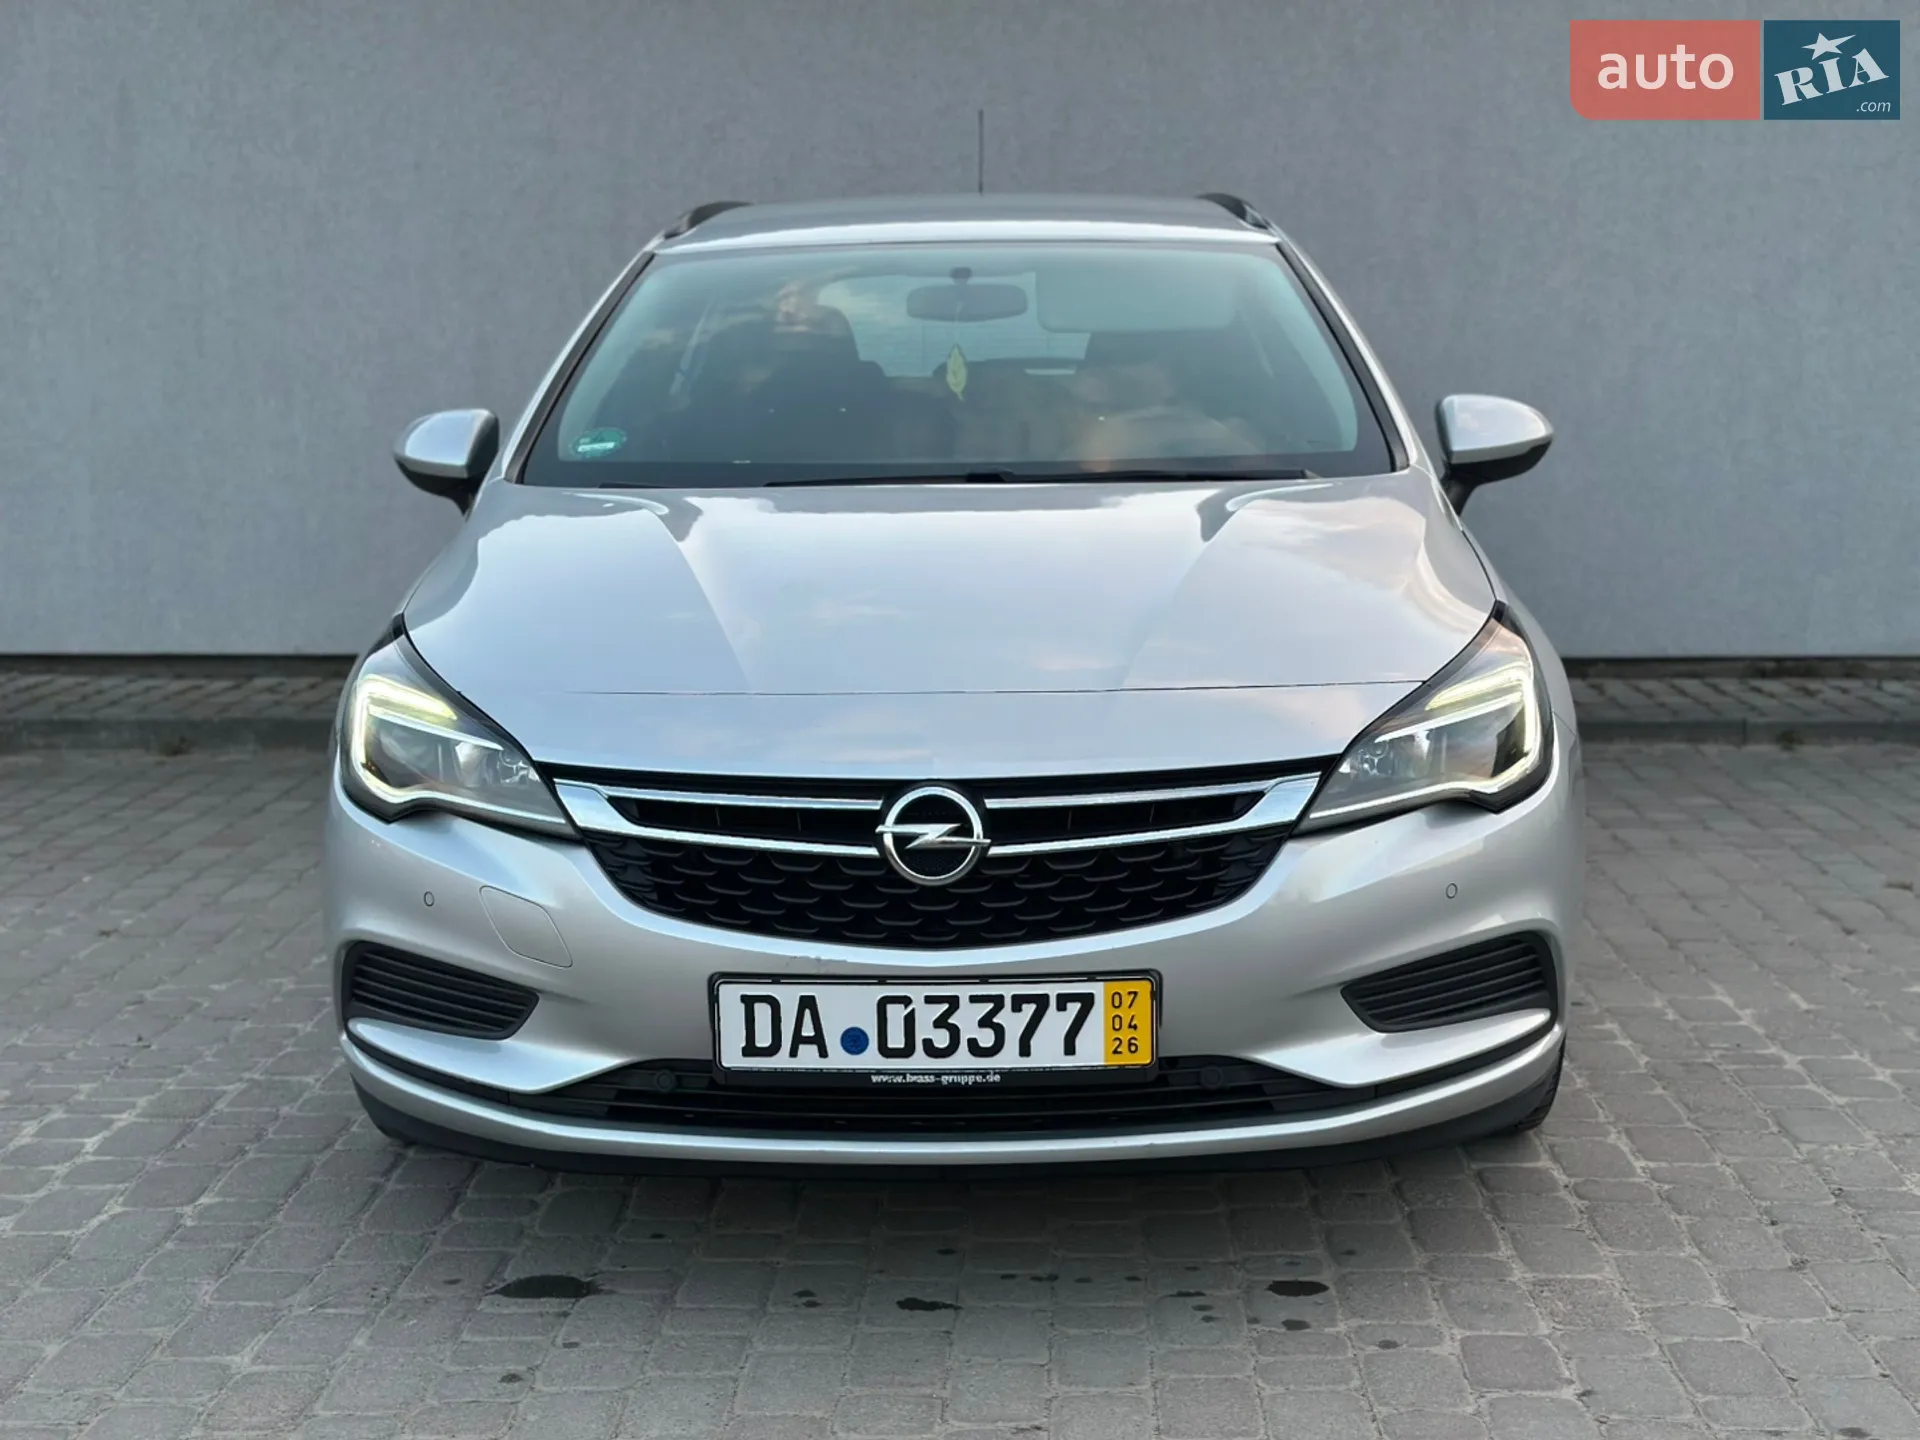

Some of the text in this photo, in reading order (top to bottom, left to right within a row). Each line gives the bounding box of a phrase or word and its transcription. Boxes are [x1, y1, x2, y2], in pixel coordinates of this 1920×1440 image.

[1110, 990, 1139, 1009] 07
[740, 992, 1095, 1059] DA 03377
[1110, 1013, 1139, 1033] 04
[1110, 1036, 1139, 1055] 26
